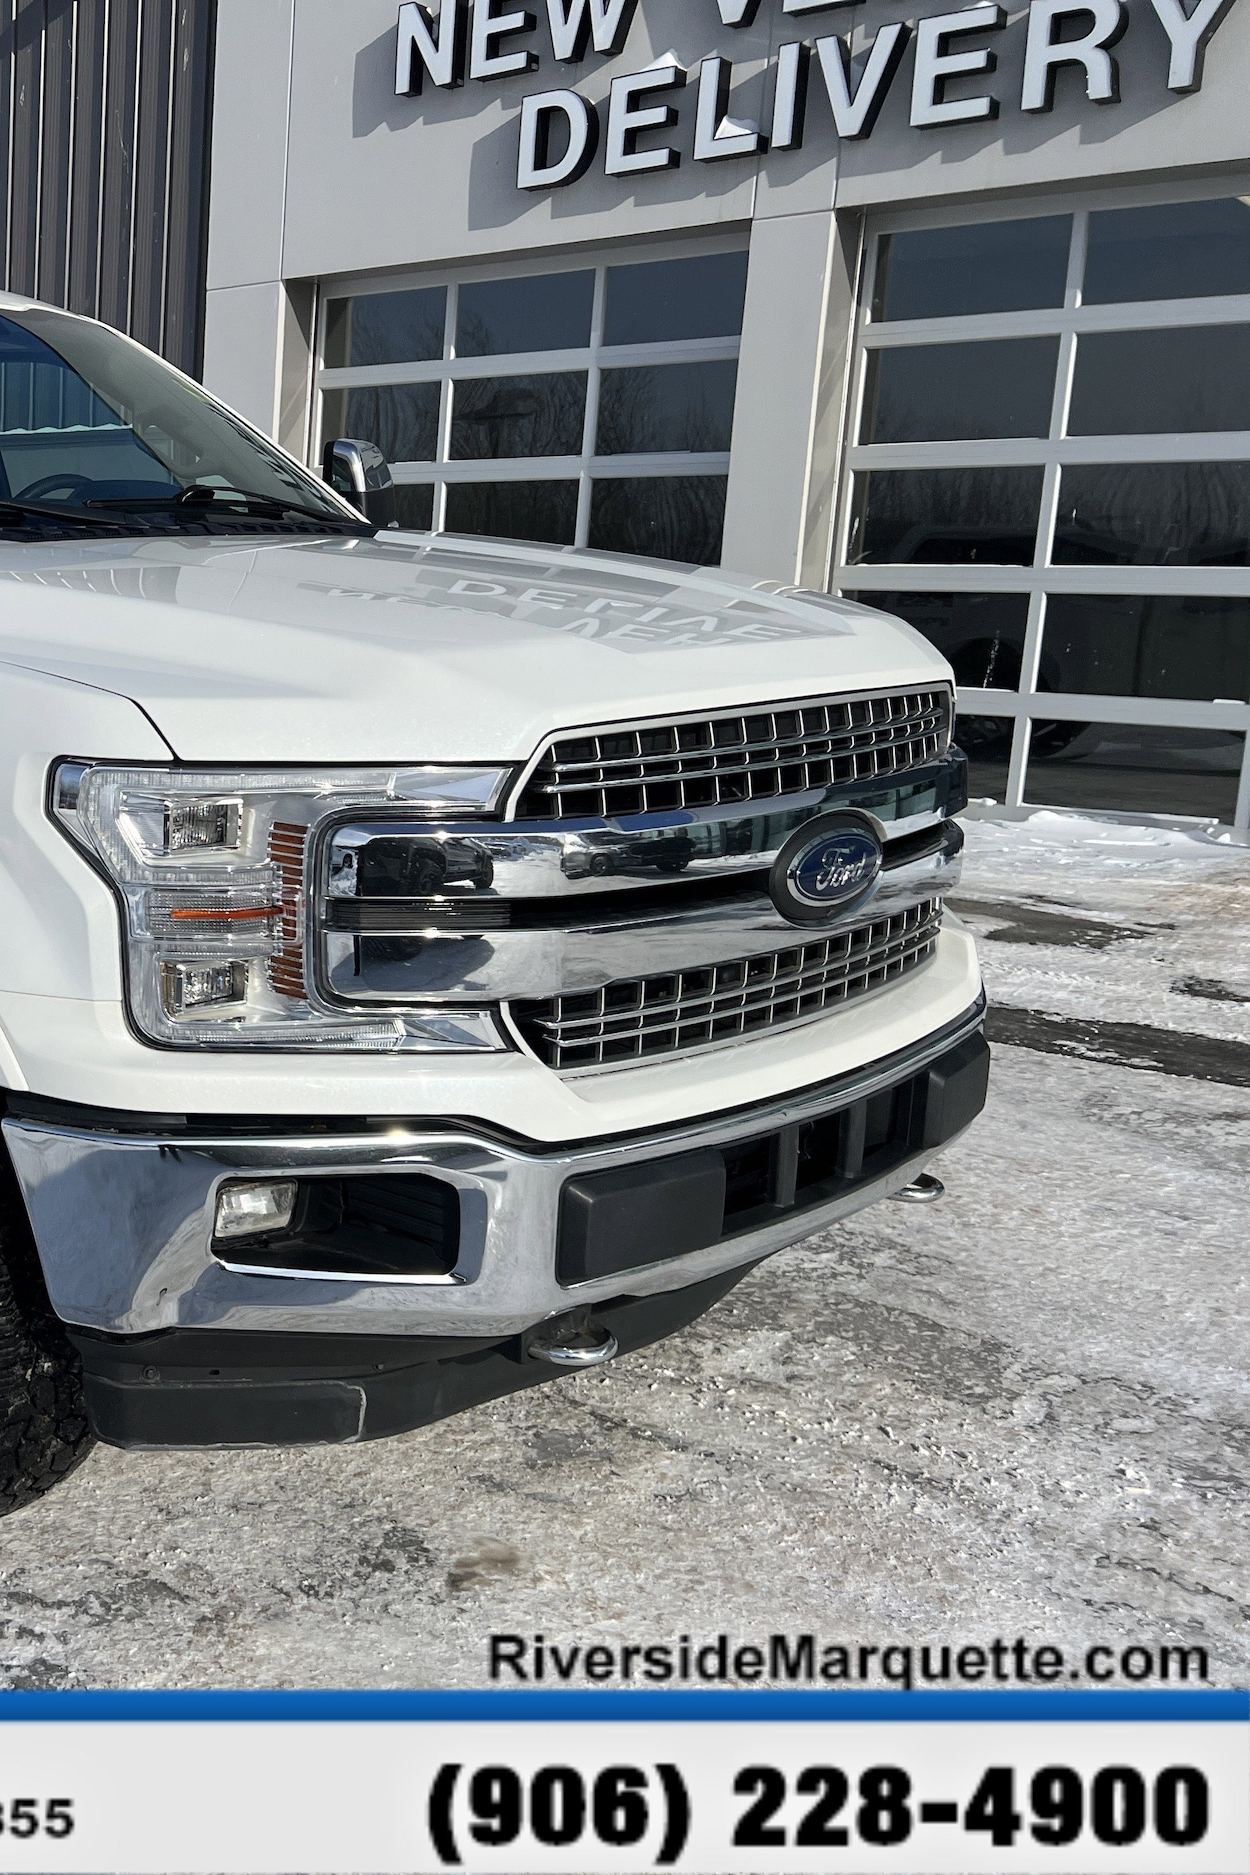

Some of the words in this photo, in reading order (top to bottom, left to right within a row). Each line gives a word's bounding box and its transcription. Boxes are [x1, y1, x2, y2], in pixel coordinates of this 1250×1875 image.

[395, 0, 638, 96] NEW
[517, 0, 1237, 191] DELIVERY
[815, 846, 867, 891] Ford
